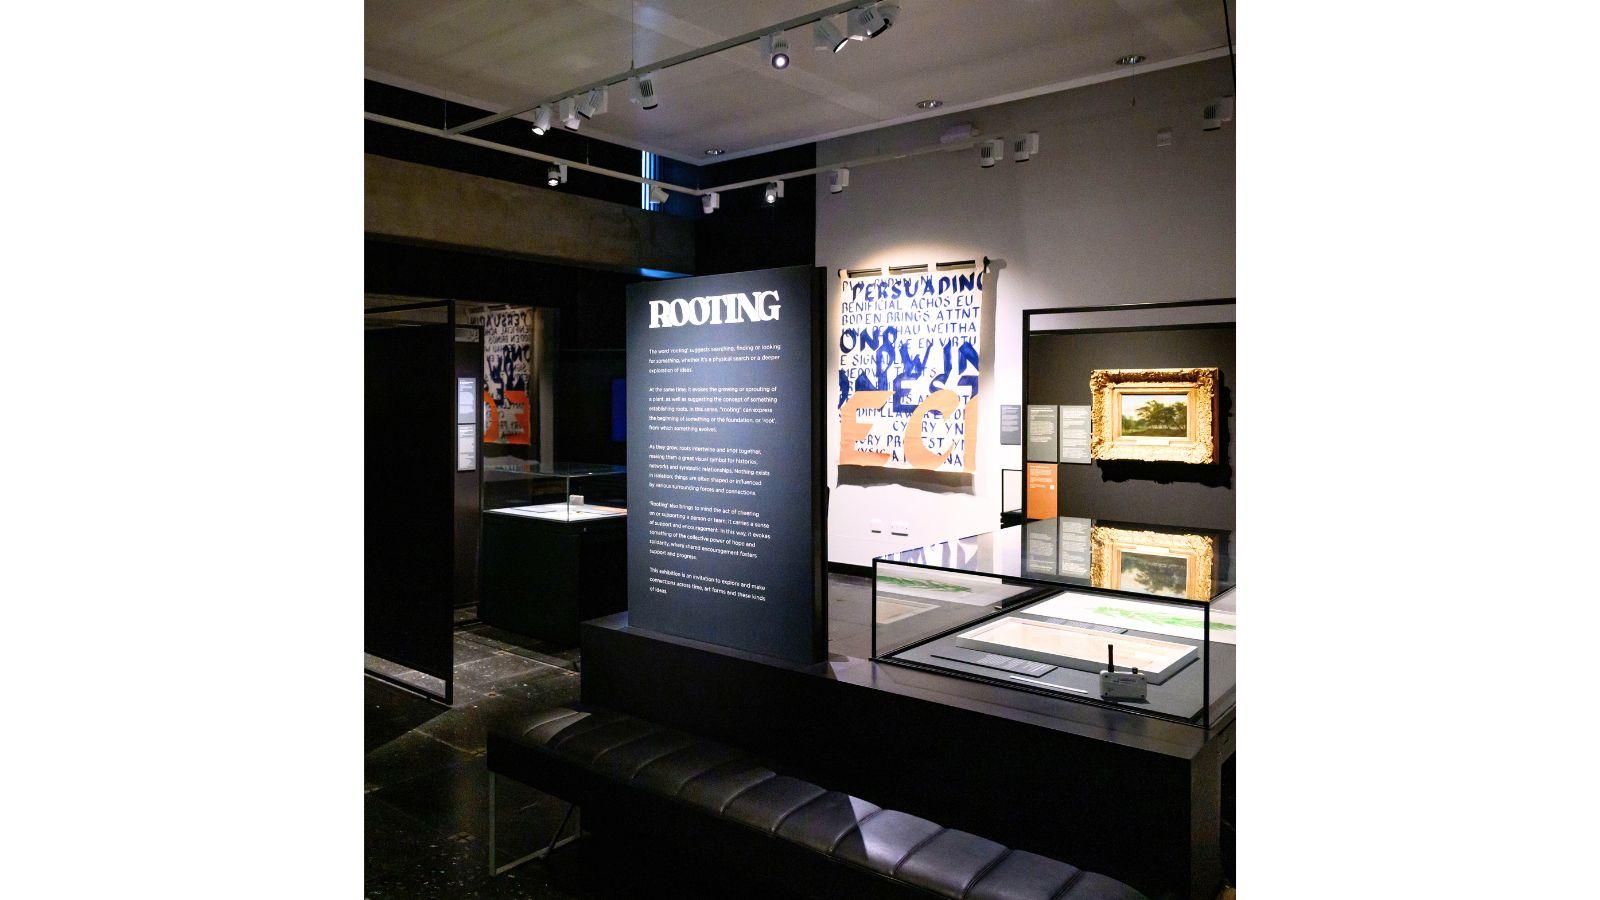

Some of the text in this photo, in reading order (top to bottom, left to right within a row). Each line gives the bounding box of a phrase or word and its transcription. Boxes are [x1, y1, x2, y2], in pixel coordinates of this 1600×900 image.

[649, 290, 781, 328] ROOTING
[842, 295, 974, 314] BENIFICIAL ACHOS EU
[887, 311, 930, 323] BRINGS
[937, 307, 980, 320] ATTNT
